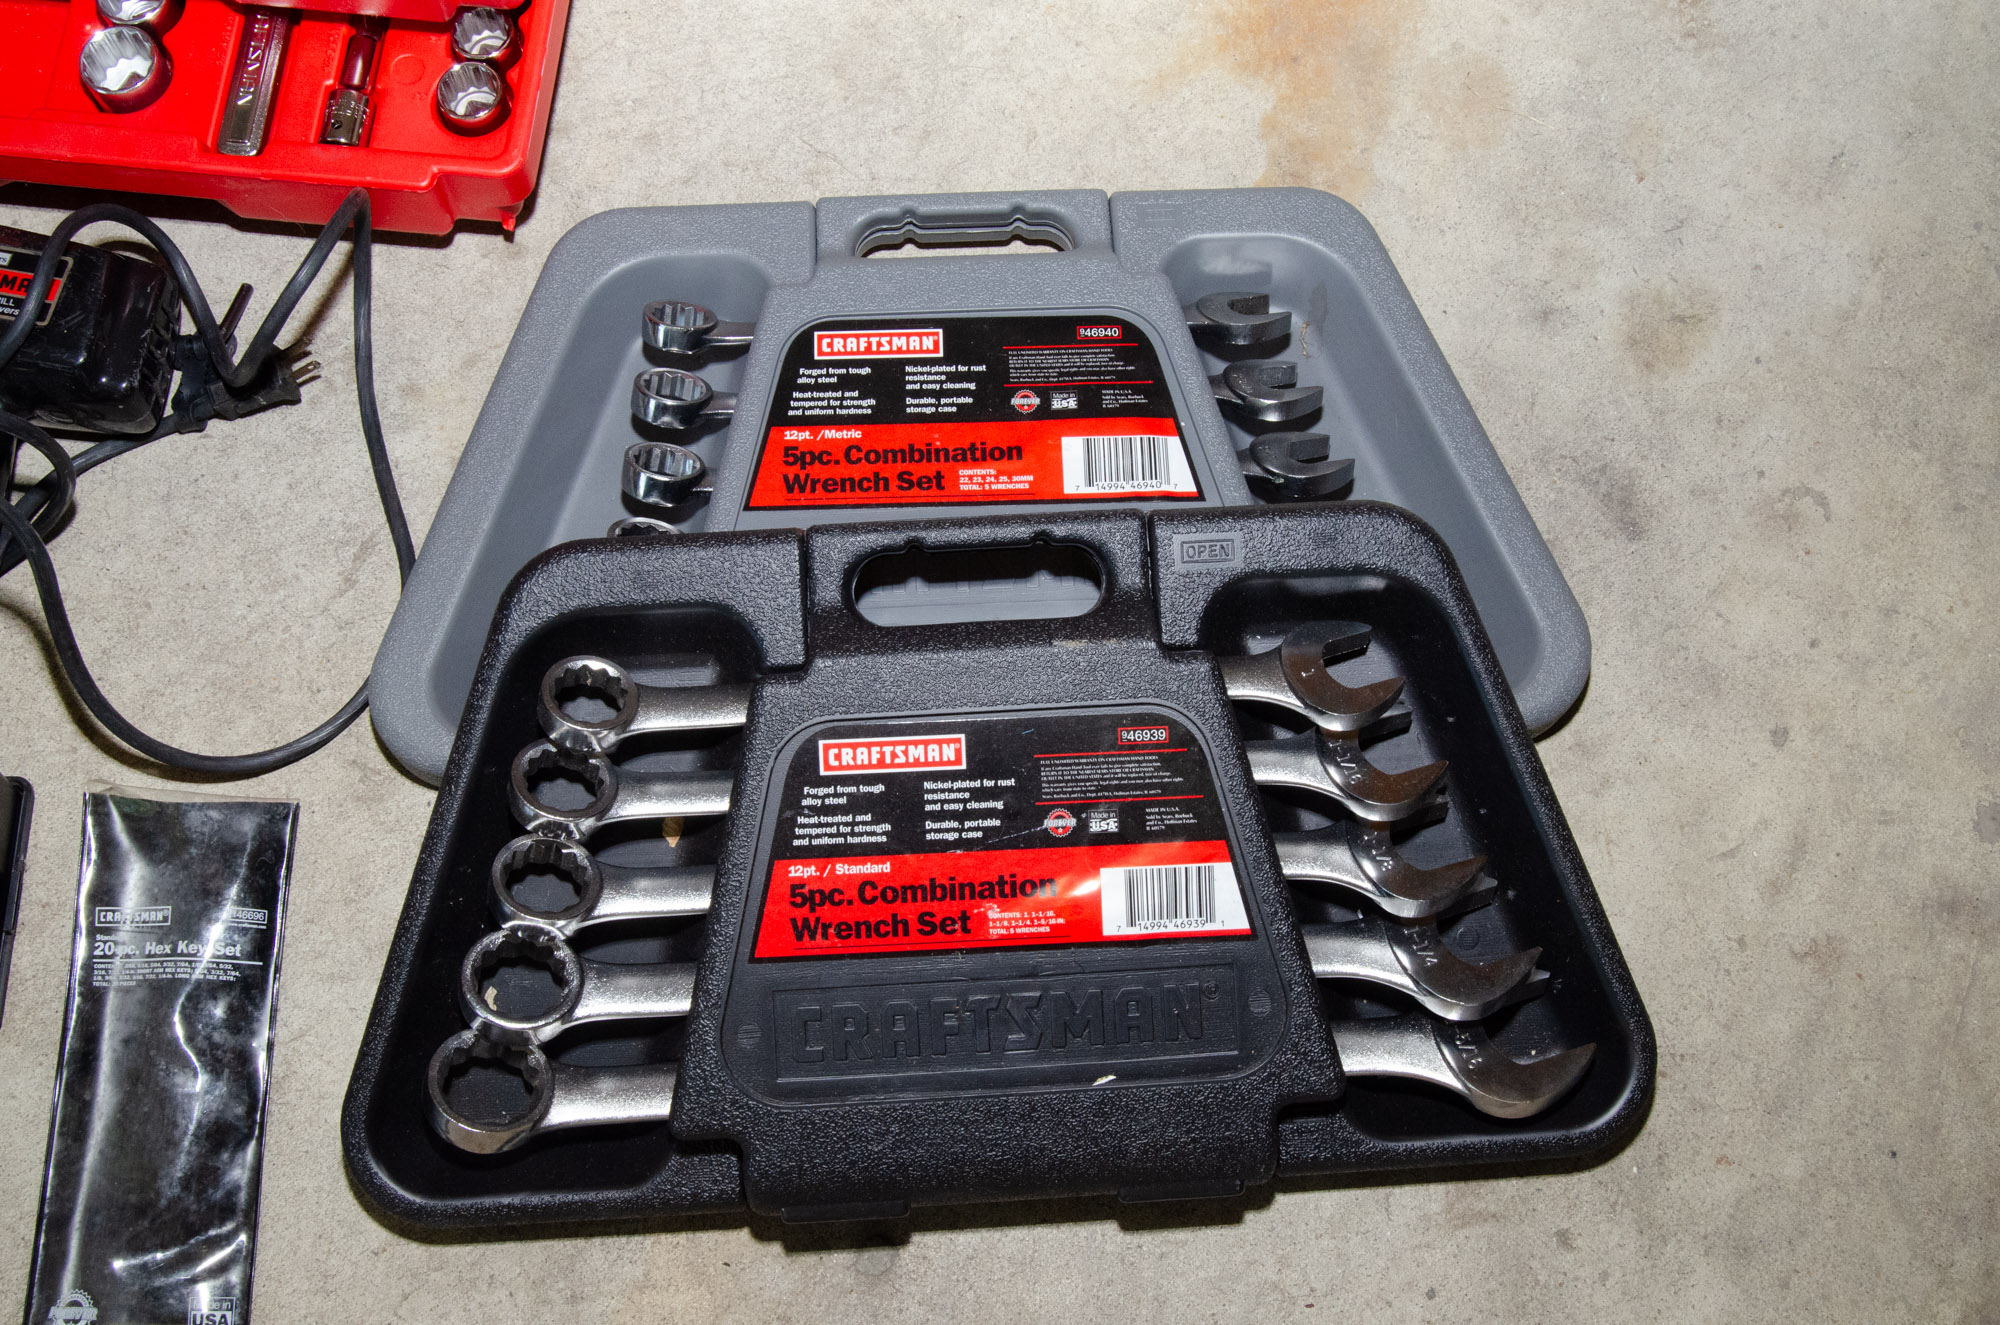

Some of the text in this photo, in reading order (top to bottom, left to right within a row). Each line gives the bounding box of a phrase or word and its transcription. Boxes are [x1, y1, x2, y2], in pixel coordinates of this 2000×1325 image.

[1079, 328, 1119, 337] 946940
[821, 336, 935, 353] CRAFTSMAN
[799, 366, 872, 376] Forged from tough
[905, 364, 987, 374] Nickel-plated for rust
[797, 376, 815, 385] alloy
[905, 373, 946, 381] resistance
[905, 381, 976, 391] and easy cleaning
[790, 398, 876, 407] tempered for strength
[905, 397, 973, 405] Durable, portable
[1053, 399, 1075, 407] USA
[787, 408, 803, 416] and
[804, 407, 834, 415] uniform
[906, 405, 936, 414] storage
[784, 430, 814, 441] 12pt.
[782, 441, 1023, 470] 5pc. Combination
[782, 470, 945, 494] Wrench Set
[1095, 482, 1125, 490] 14994
[1130, 480, 1162, 489] 46940
[1186, 543, 1229, 559] OPEN
[1121, 729, 1166, 742] 946939
[828, 743, 956, 766] CRAFTSMAN
[923, 778, 1015, 790] Nickel-plated for rust
[803, 784, 885, 796] Forged from tough
[801, 796, 847, 806] alloy steel
[924, 791, 970, 801] resistance
[924, 800, 1004, 812] and easy cleaning
[797, 813, 871, 824] Heat-treated and
[1090, 811, 1110, 819] Made
[795, 823, 892, 835] tempered for strength
[925, 818, 1001, 830] Durable, portable
[1091, 821, 1116, 831] USA
[792, 834, 887, 846] and uniform hardness
[926, 830, 983, 841] storage case
[788, 862, 891, 877] 12pt. / Standard
[789, 873, 1057, 913] 5pc. Combination
[230, 910, 265, 921] 46696
[789, 910, 971, 941] Wrench Set
[1116, 925, 1121, 933] 7
[1137, 921, 1168, 931] 14994
[1173, 919, 1206, 929] 46939
[145, 941, 172, 955] Hex
[176, 940, 206, 956] Key
[214, 941, 241, 957] Set
[793, 981, 1202, 1064] CRAFTSMAN
[222, 1300, 231, 1310] in
[192, 1313, 229, 1325] USA
